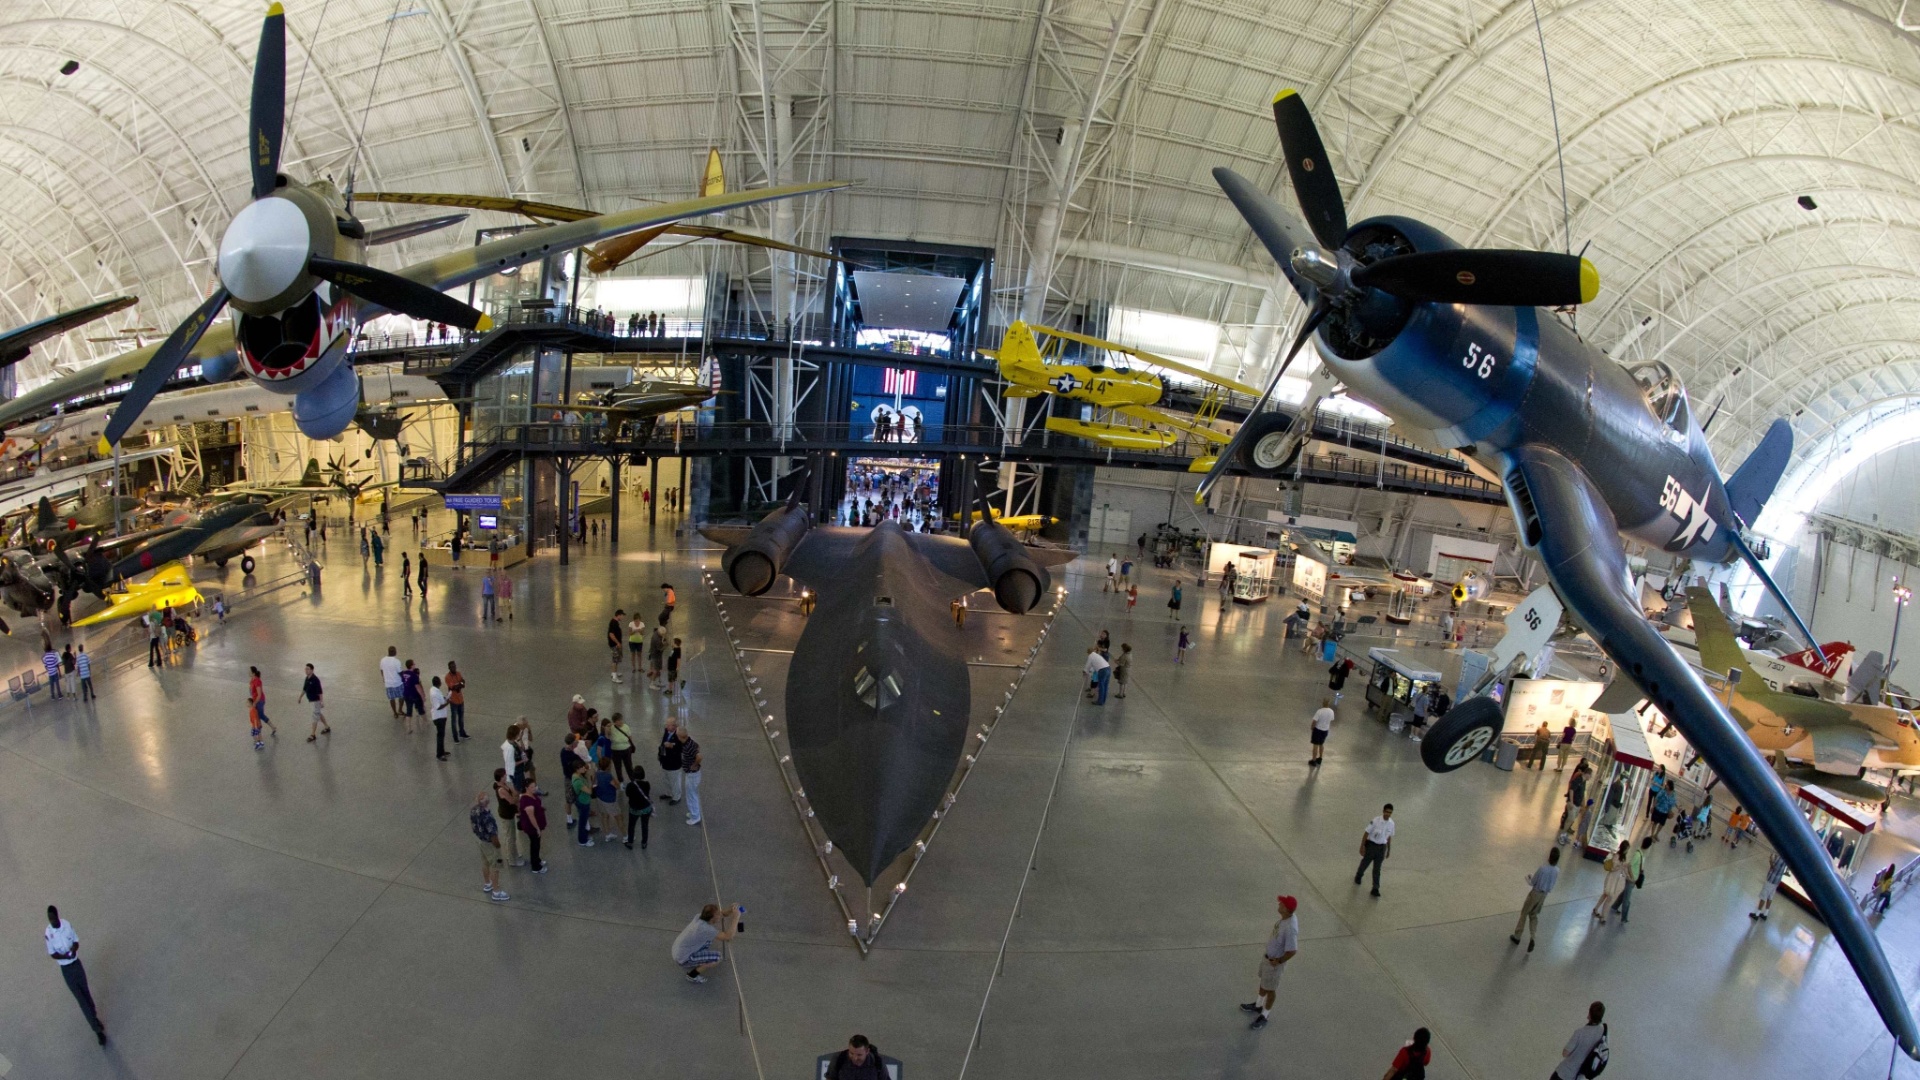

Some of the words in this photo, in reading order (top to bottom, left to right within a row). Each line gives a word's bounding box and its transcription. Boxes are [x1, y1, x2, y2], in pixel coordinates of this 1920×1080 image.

[1463, 342, 1495, 379] 56
[1321, 366, 1330, 379] 56
[1085, 377, 1106, 394] 44
[1659, 474, 1681, 512] 56
[1525, 608, 1541, 630] 56
[1768, 661, 1785, 671] 7307
